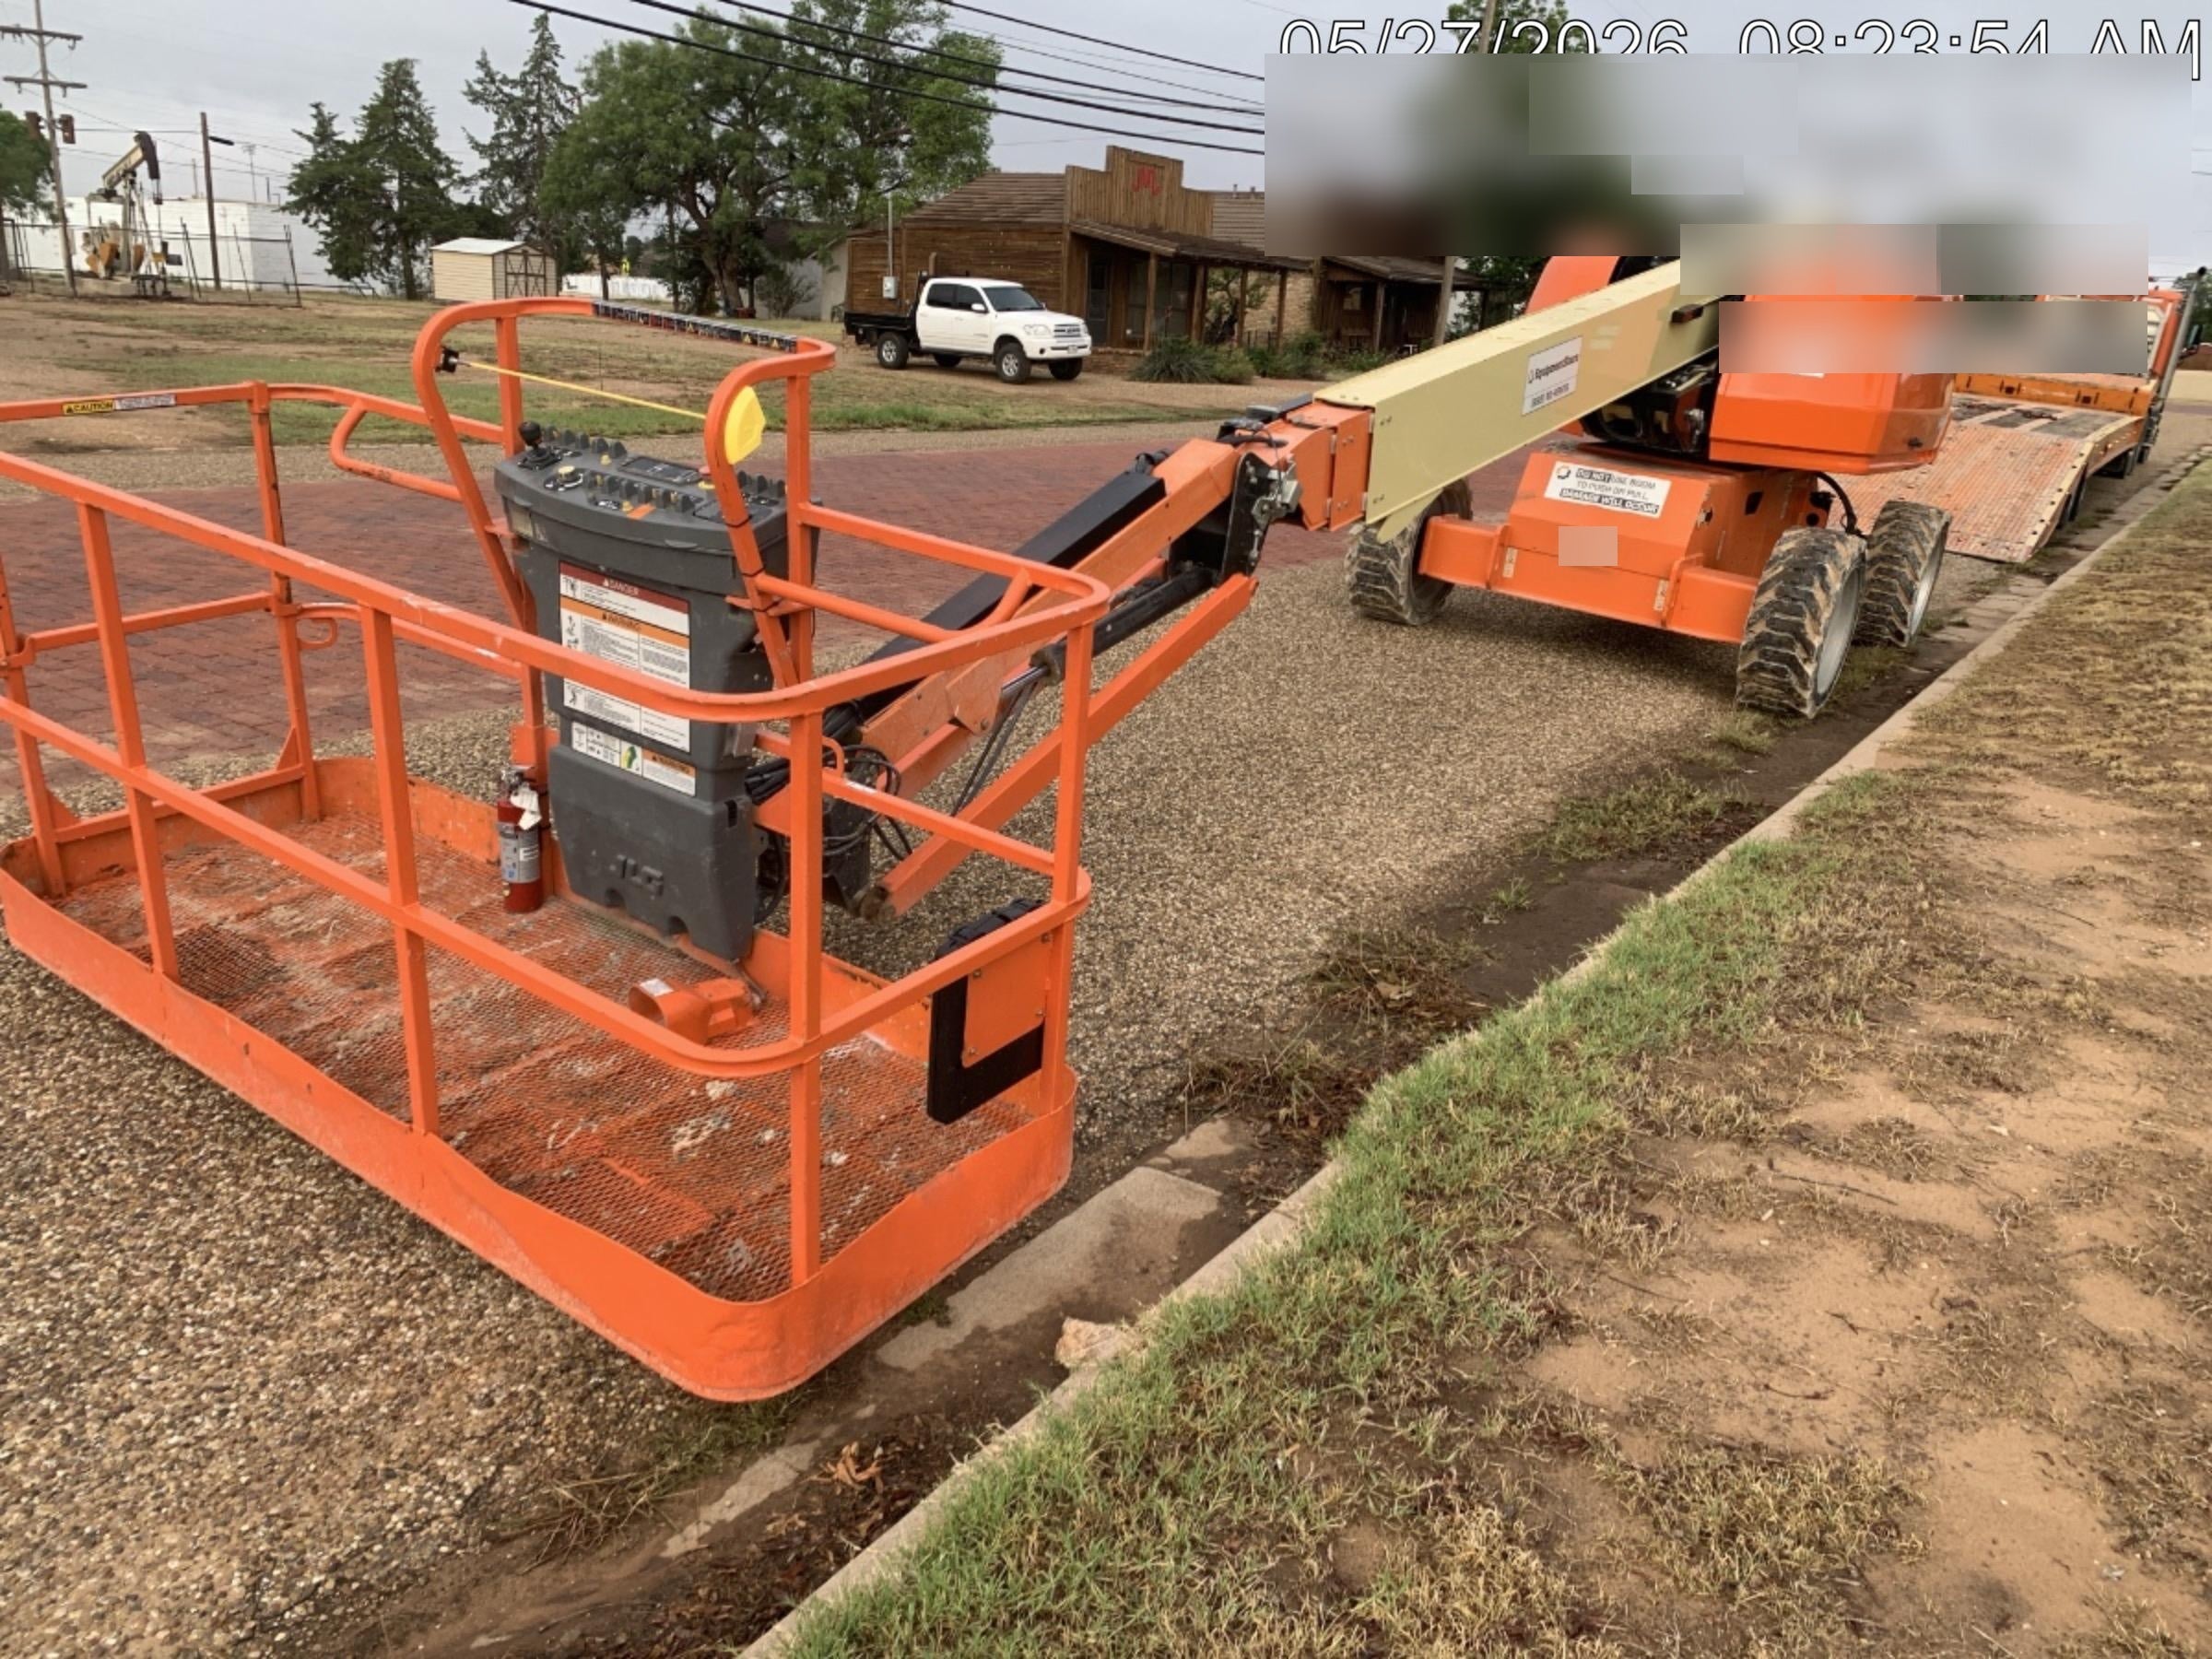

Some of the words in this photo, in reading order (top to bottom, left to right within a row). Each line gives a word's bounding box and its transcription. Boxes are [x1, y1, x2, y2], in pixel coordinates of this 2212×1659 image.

[74, 400, 112, 413] CAUTION
[1591, 470, 1611, 483] NOT
[608, 579, 640, 595] DANGER
